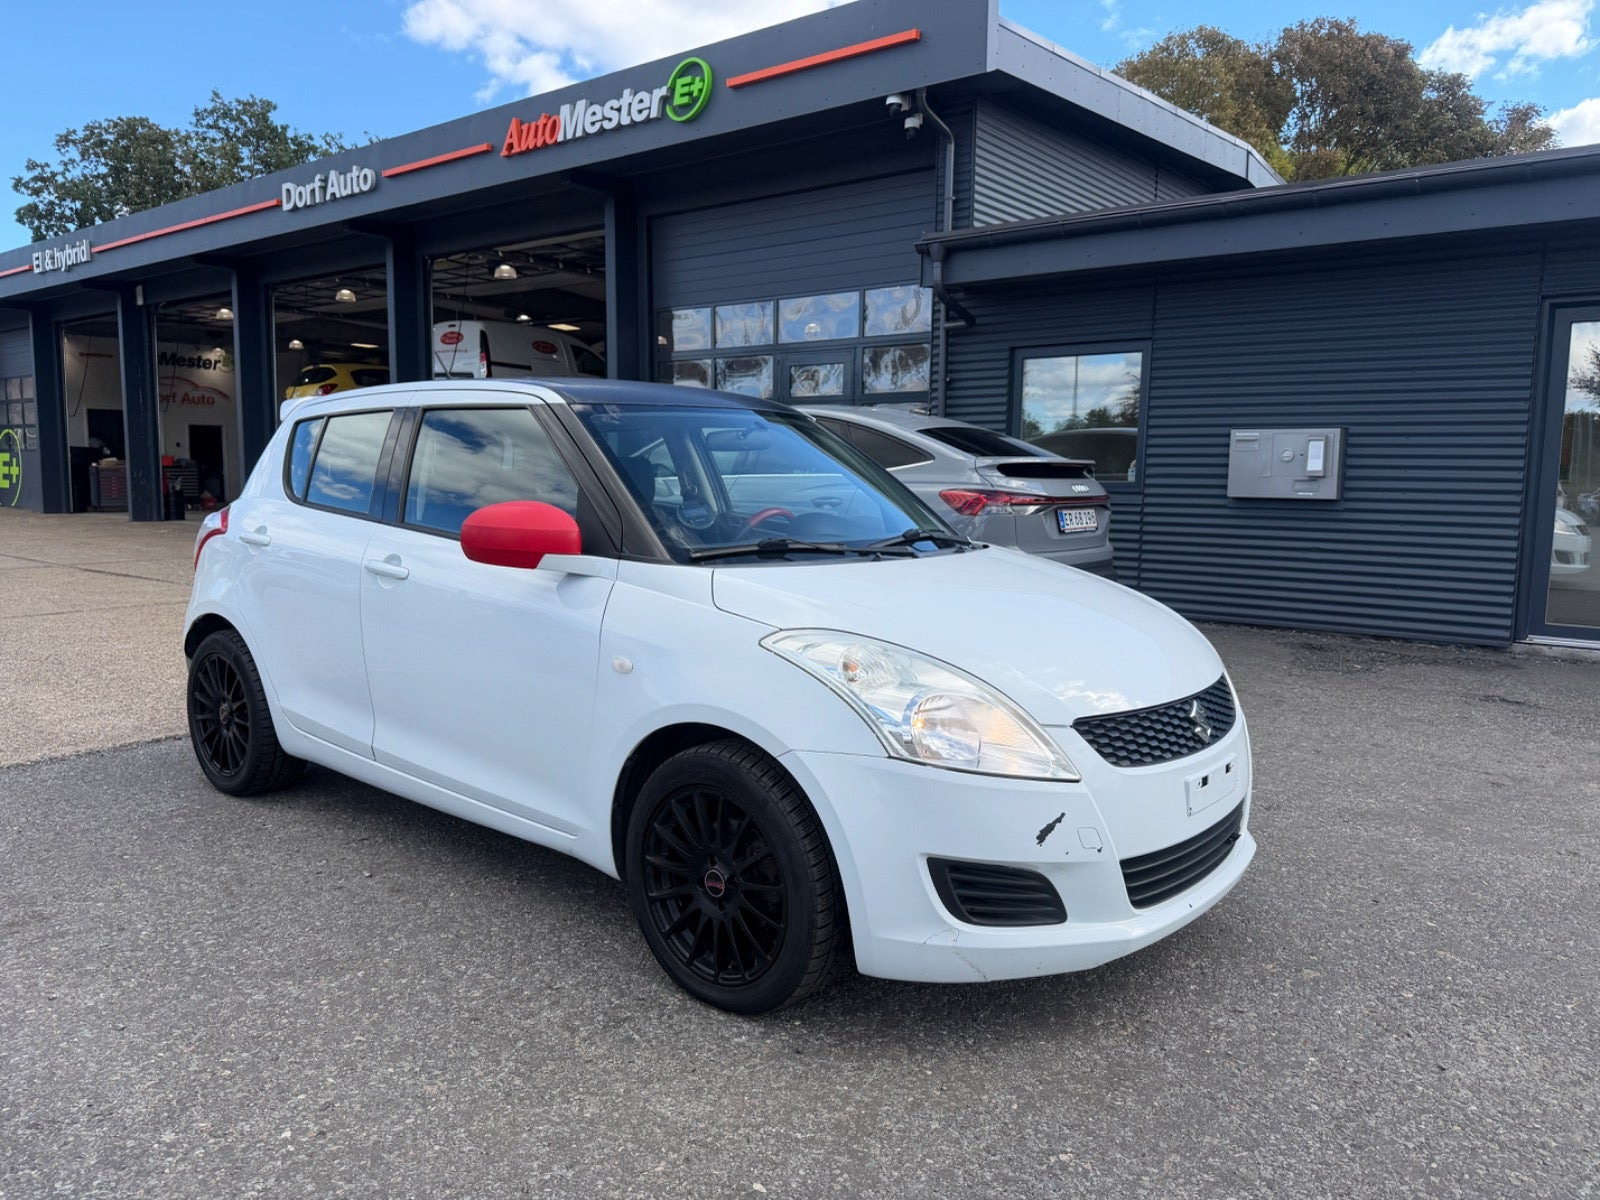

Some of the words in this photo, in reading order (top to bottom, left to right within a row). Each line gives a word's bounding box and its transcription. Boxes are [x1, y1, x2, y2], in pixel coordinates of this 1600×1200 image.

[500, 85, 670, 157] AutoMester
[281, 173, 325, 212] Dorf
[326, 164, 376, 201] Auto
[32, 251, 44, 274] El
[45, 249, 55, 271] &
[54, 238, 91, 272] hybrid
[181, 392, 215, 406] Auto
[1064, 512, 1074, 526] ER
